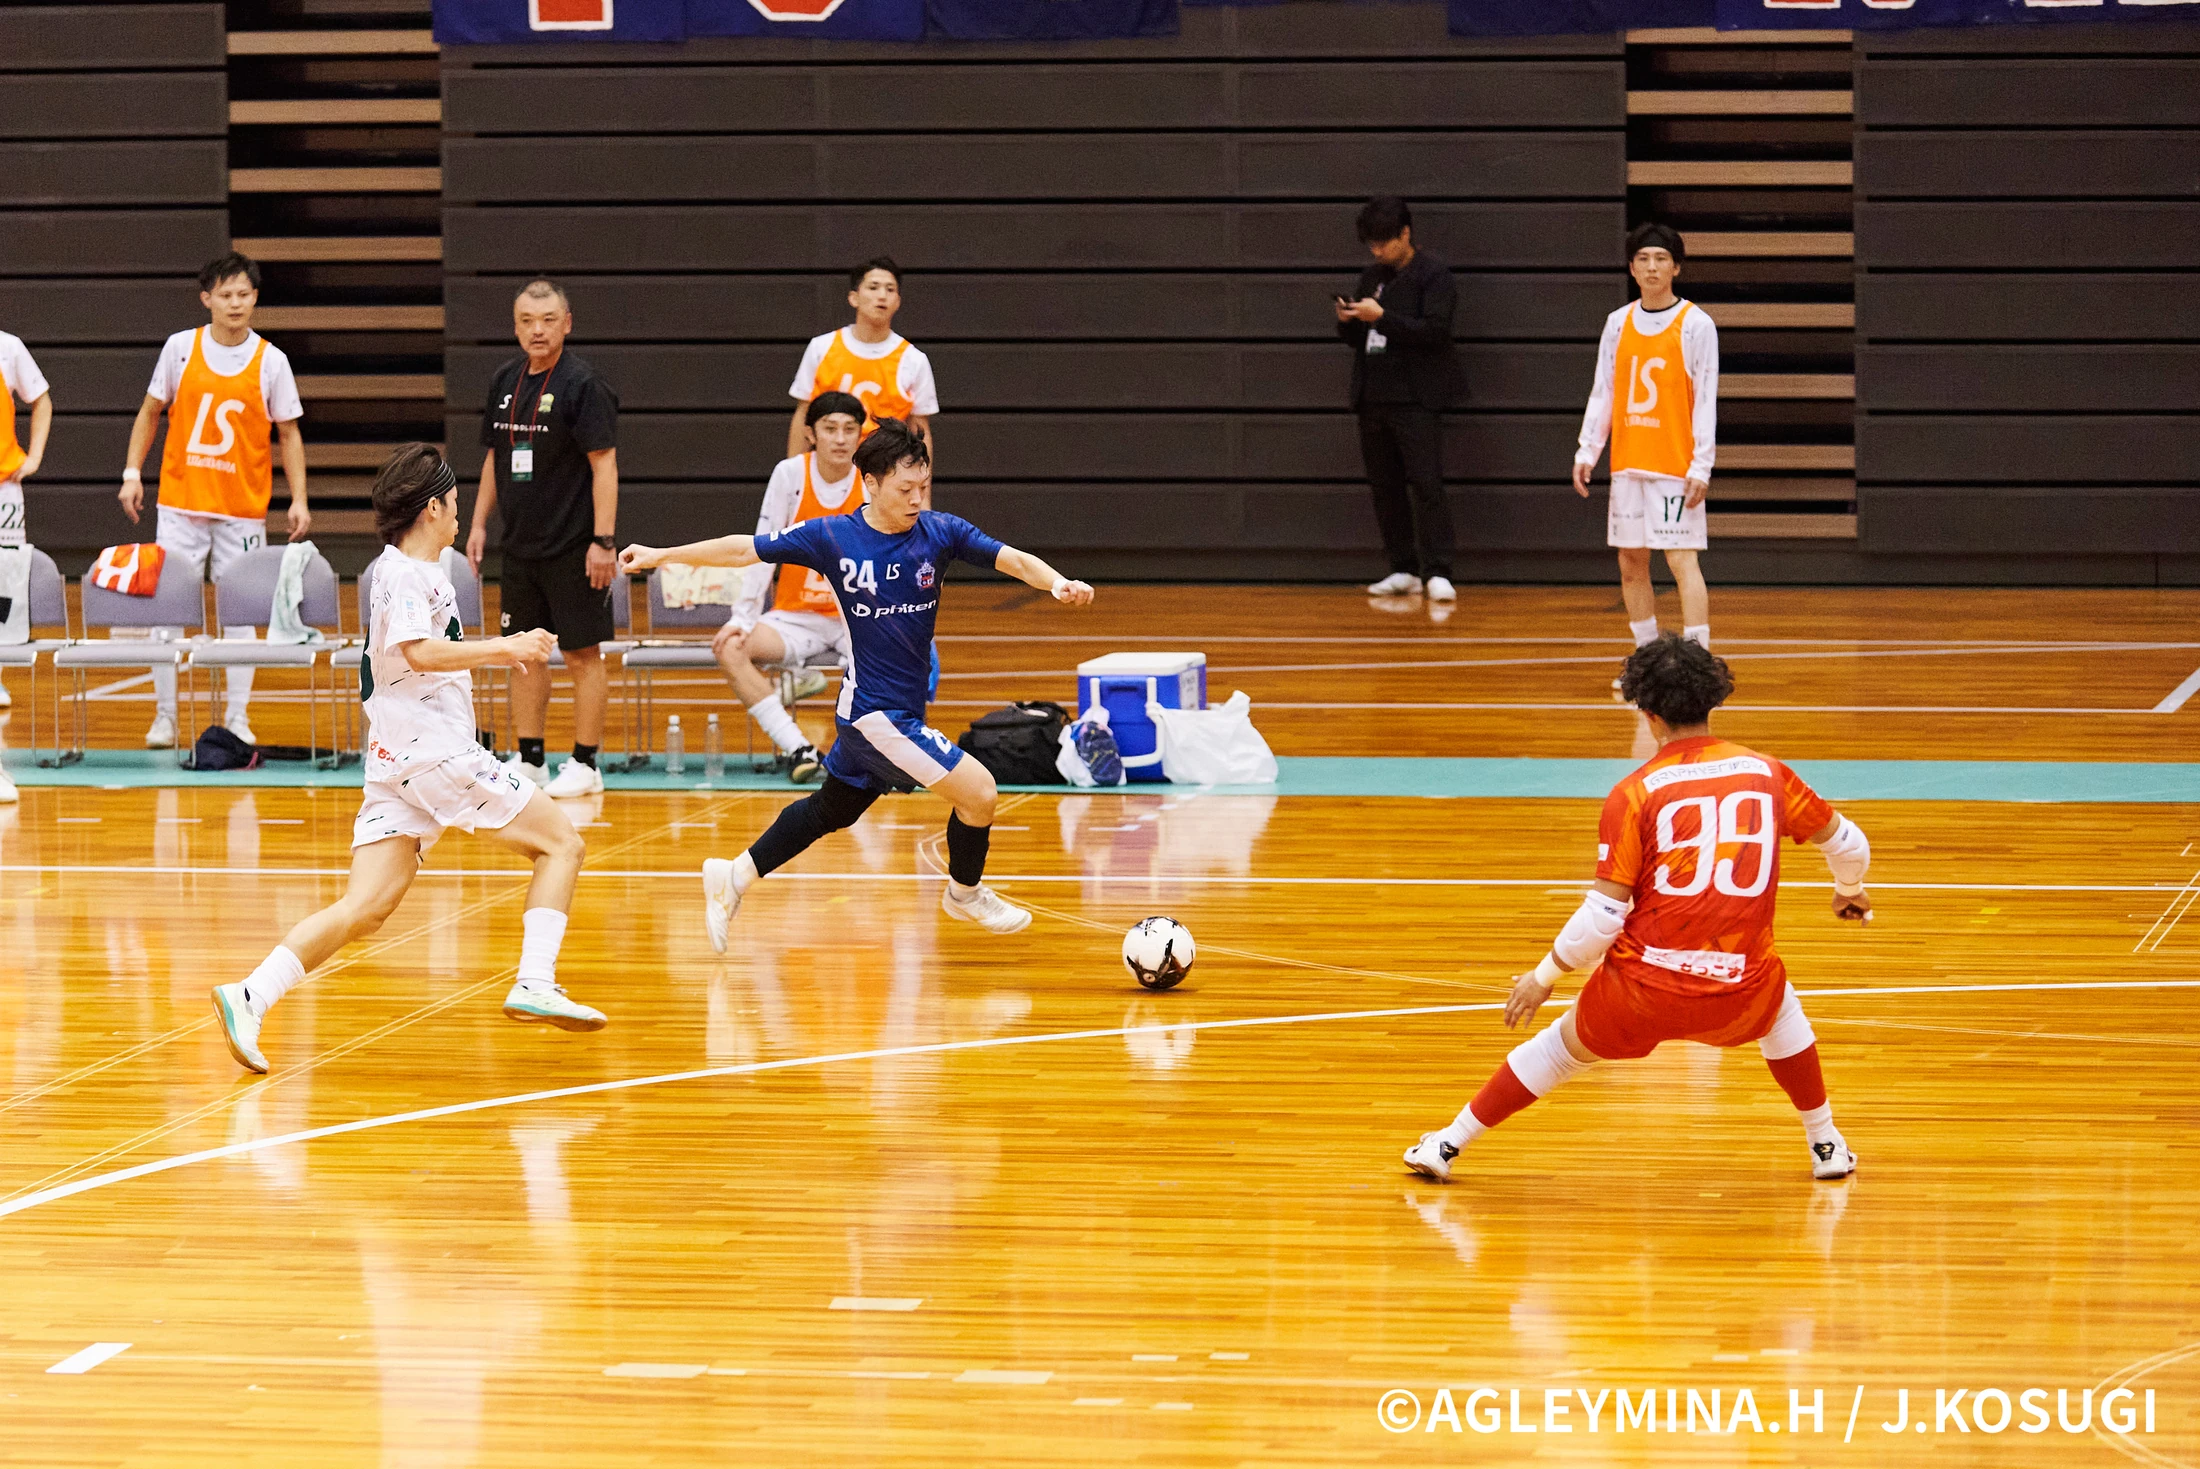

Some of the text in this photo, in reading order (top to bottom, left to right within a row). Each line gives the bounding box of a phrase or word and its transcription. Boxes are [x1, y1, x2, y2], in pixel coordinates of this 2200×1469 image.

[1626, 355, 1666, 414] LS
[186, 393, 246, 456] LS
[1663, 495, 1685, 523] 17
[839, 557, 878, 596] 24
[886, 563, 901, 580] LS
[874, 600, 937, 619] phiten
[1653, 790, 1774, 898] 99
